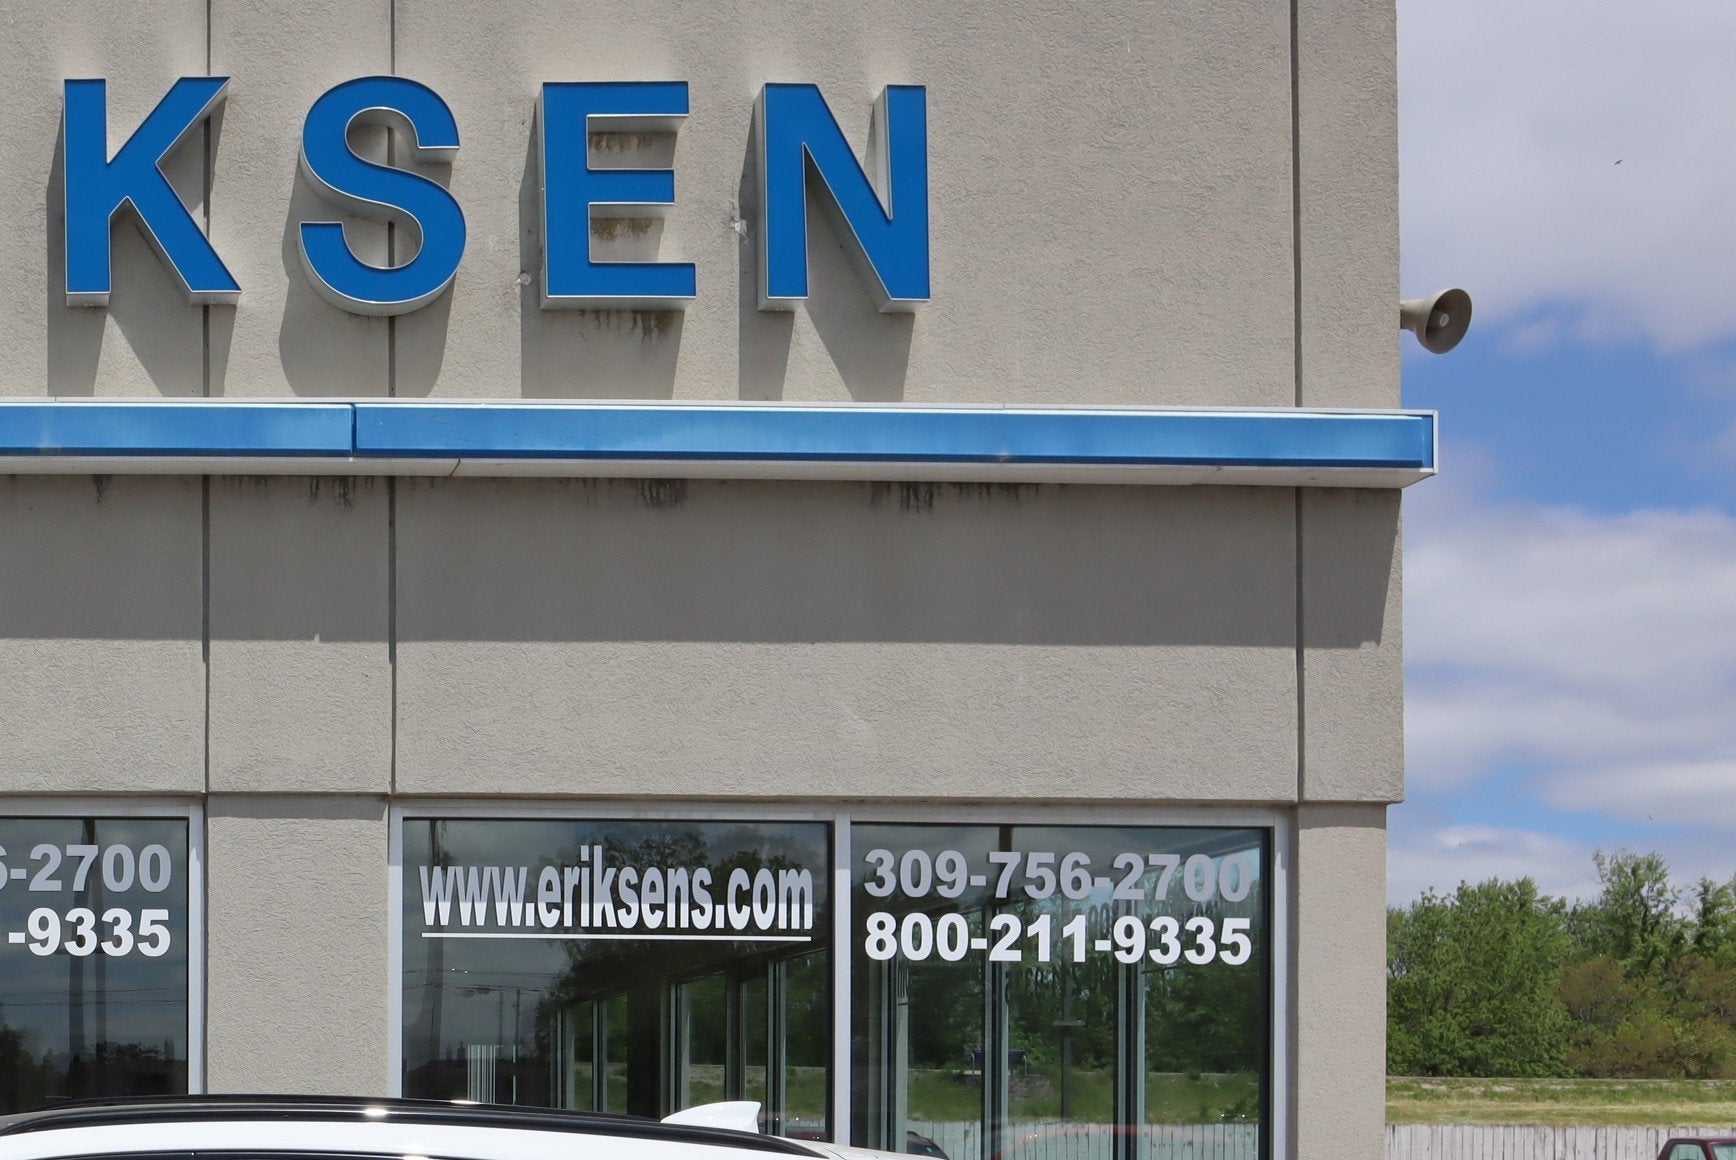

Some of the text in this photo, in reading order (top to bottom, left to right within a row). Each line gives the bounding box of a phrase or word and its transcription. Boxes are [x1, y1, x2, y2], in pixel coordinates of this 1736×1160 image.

[418, 845, 814, 932] www.eriksens.com
[863, 848, 1253, 903] 309-756-2700
[864, 911, 1253, 967] 800-211-9335
